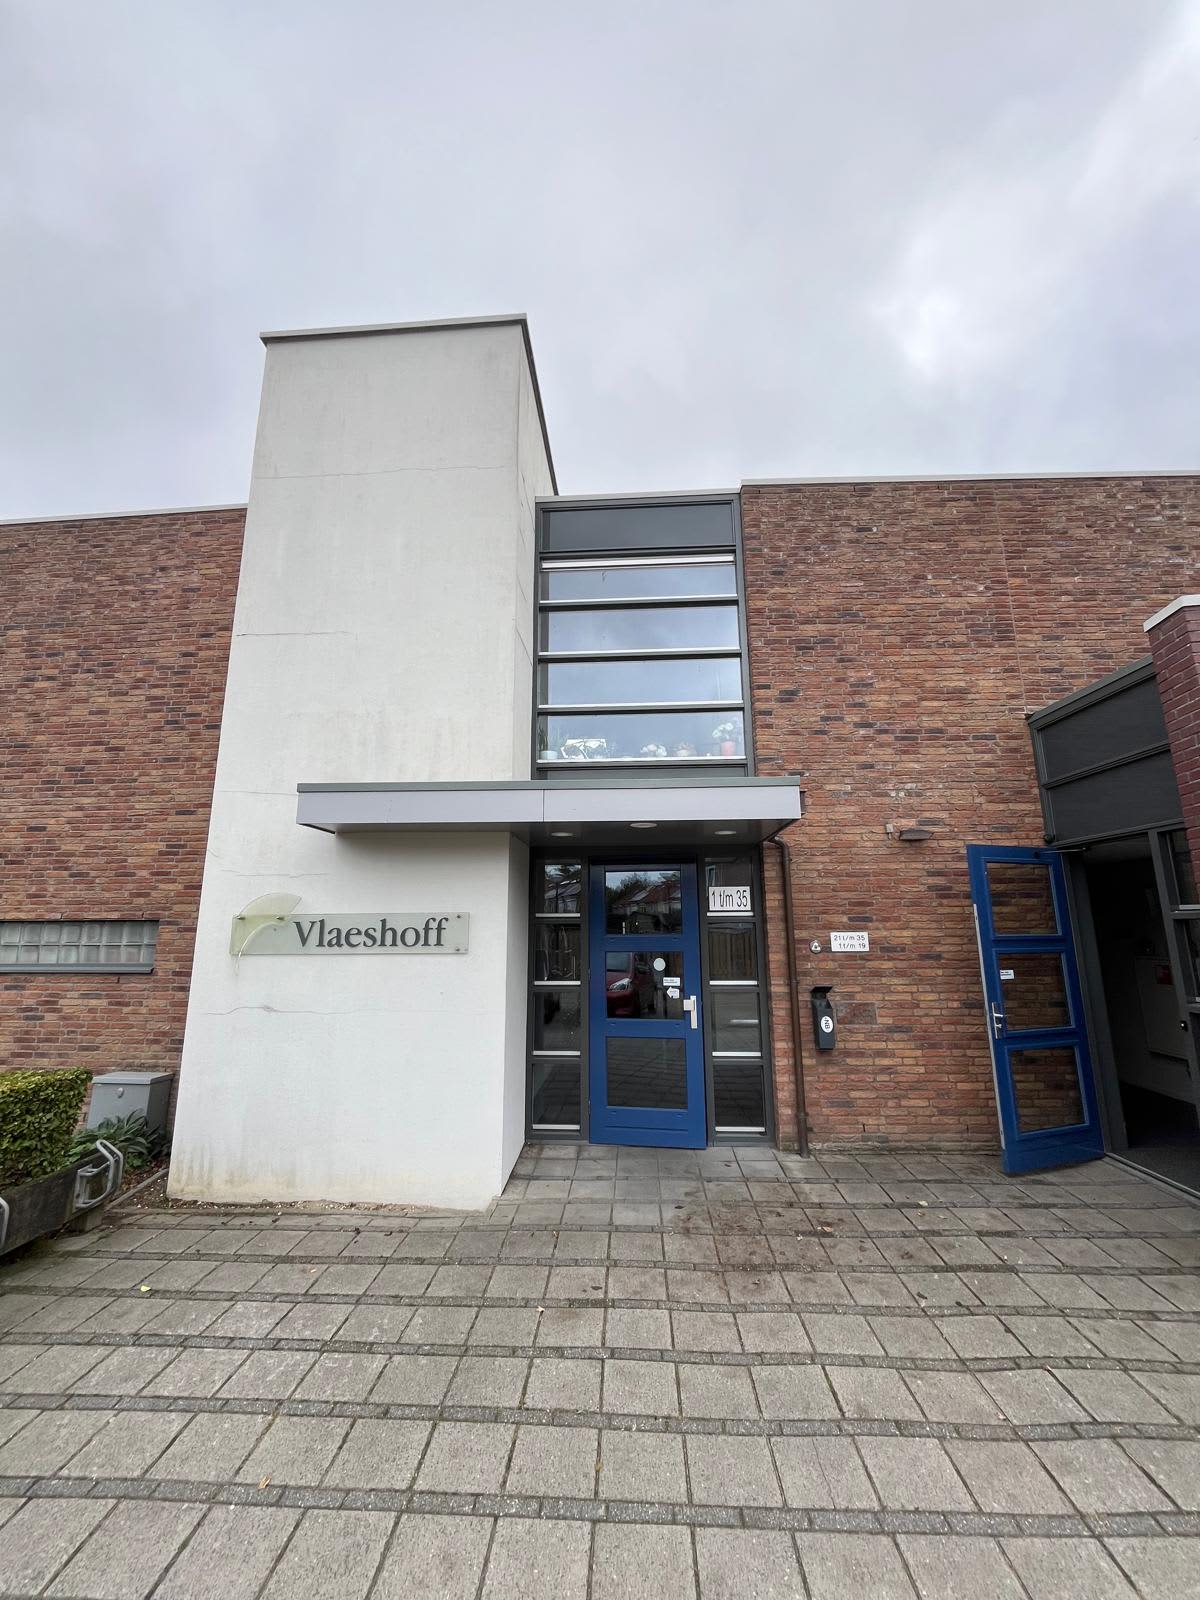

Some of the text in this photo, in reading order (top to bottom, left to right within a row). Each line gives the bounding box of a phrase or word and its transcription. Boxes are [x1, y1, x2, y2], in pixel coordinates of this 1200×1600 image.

[712, 889, 748, 908] 1 t/m 35
[293, 917, 449, 947] Vlaeshoff
